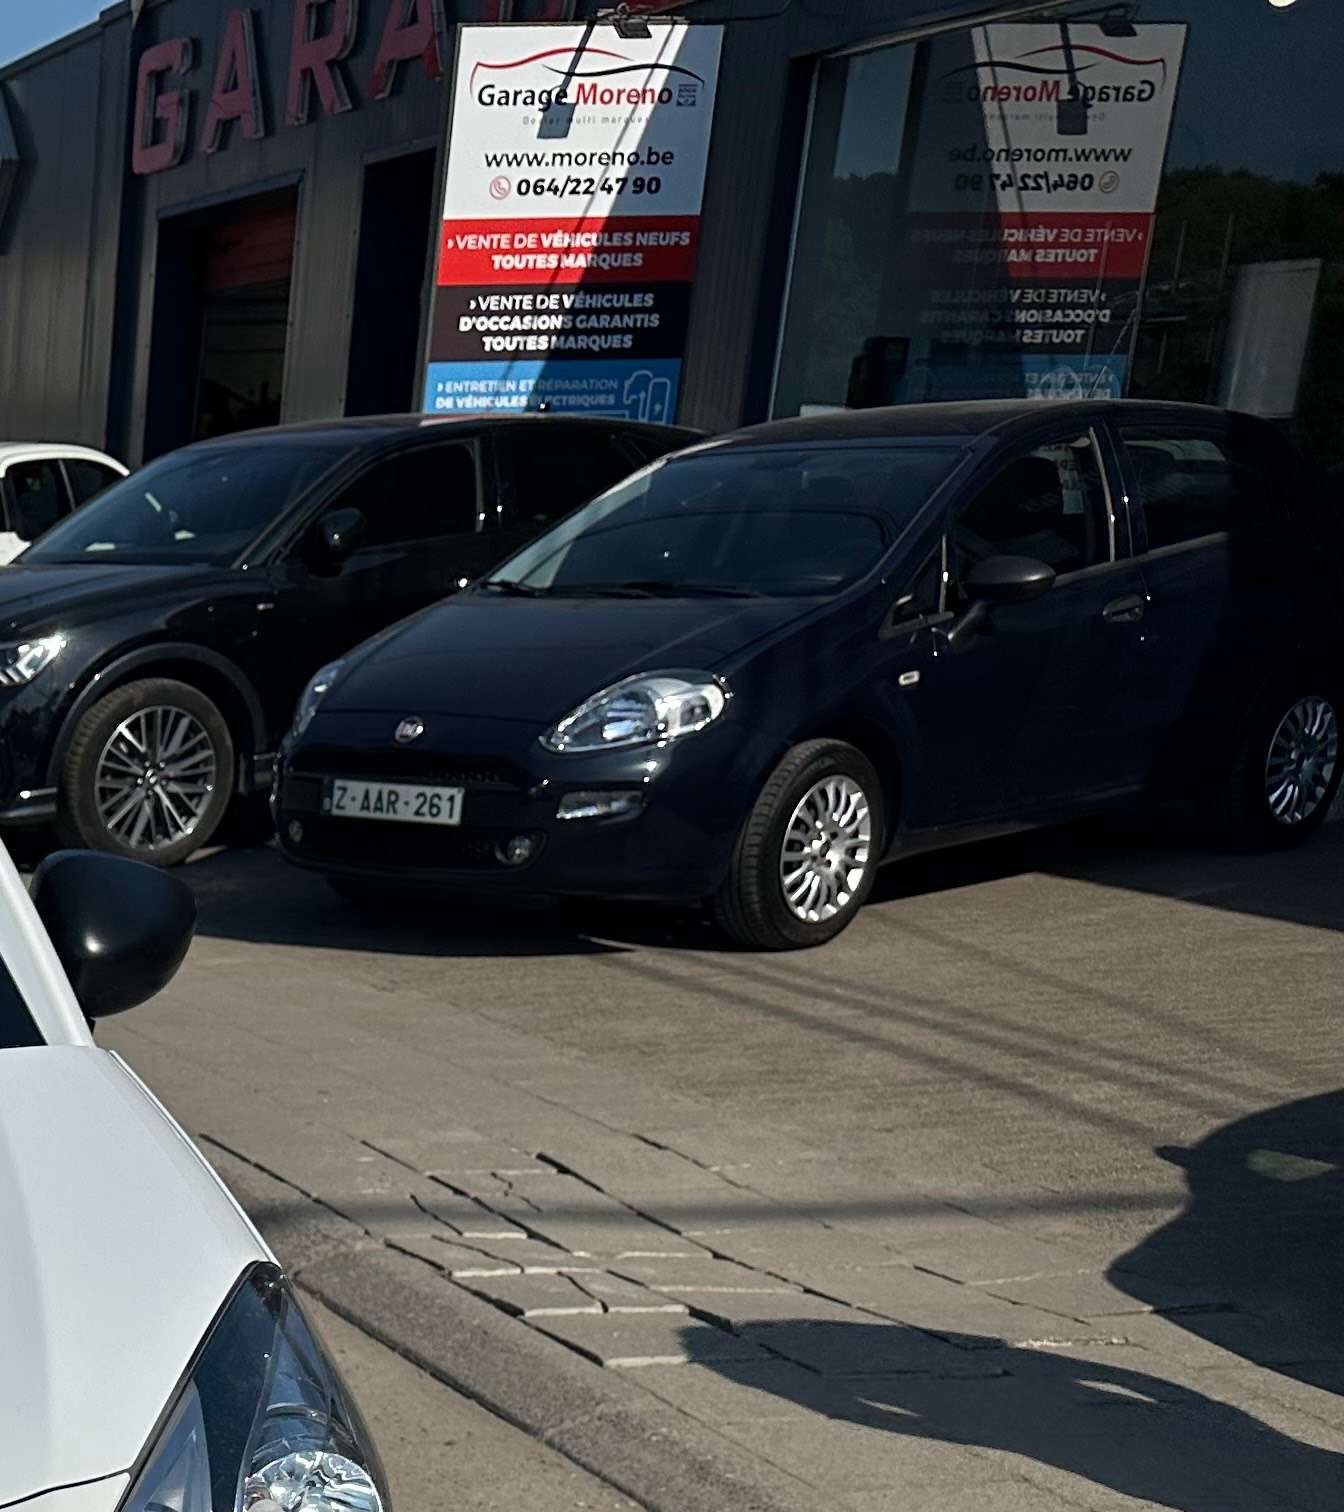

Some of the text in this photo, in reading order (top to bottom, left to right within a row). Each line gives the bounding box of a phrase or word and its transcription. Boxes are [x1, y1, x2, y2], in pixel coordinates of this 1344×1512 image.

[132, 0, 574, 176] GARA
[478, 84, 568, 112] Garage
[575, 83, 673, 106] Moreno
[485, 147, 674, 168] www.moreno.be
[516, 175, 662, 198] 064/22 47 90
[455, 229, 691, 249] VENTE DE VÉHICULES NEUFS
[492, 253, 644, 269] TOUTES MARQUES
[477, 291, 655, 310] VENTE DE VÉHICULES
[459, 313, 661, 332] D'OCCASIONS GARANTIS
[481, 334, 634, 352] TOUTES MARQUES
[334, 786, 456, 819] Z-AAR-261
